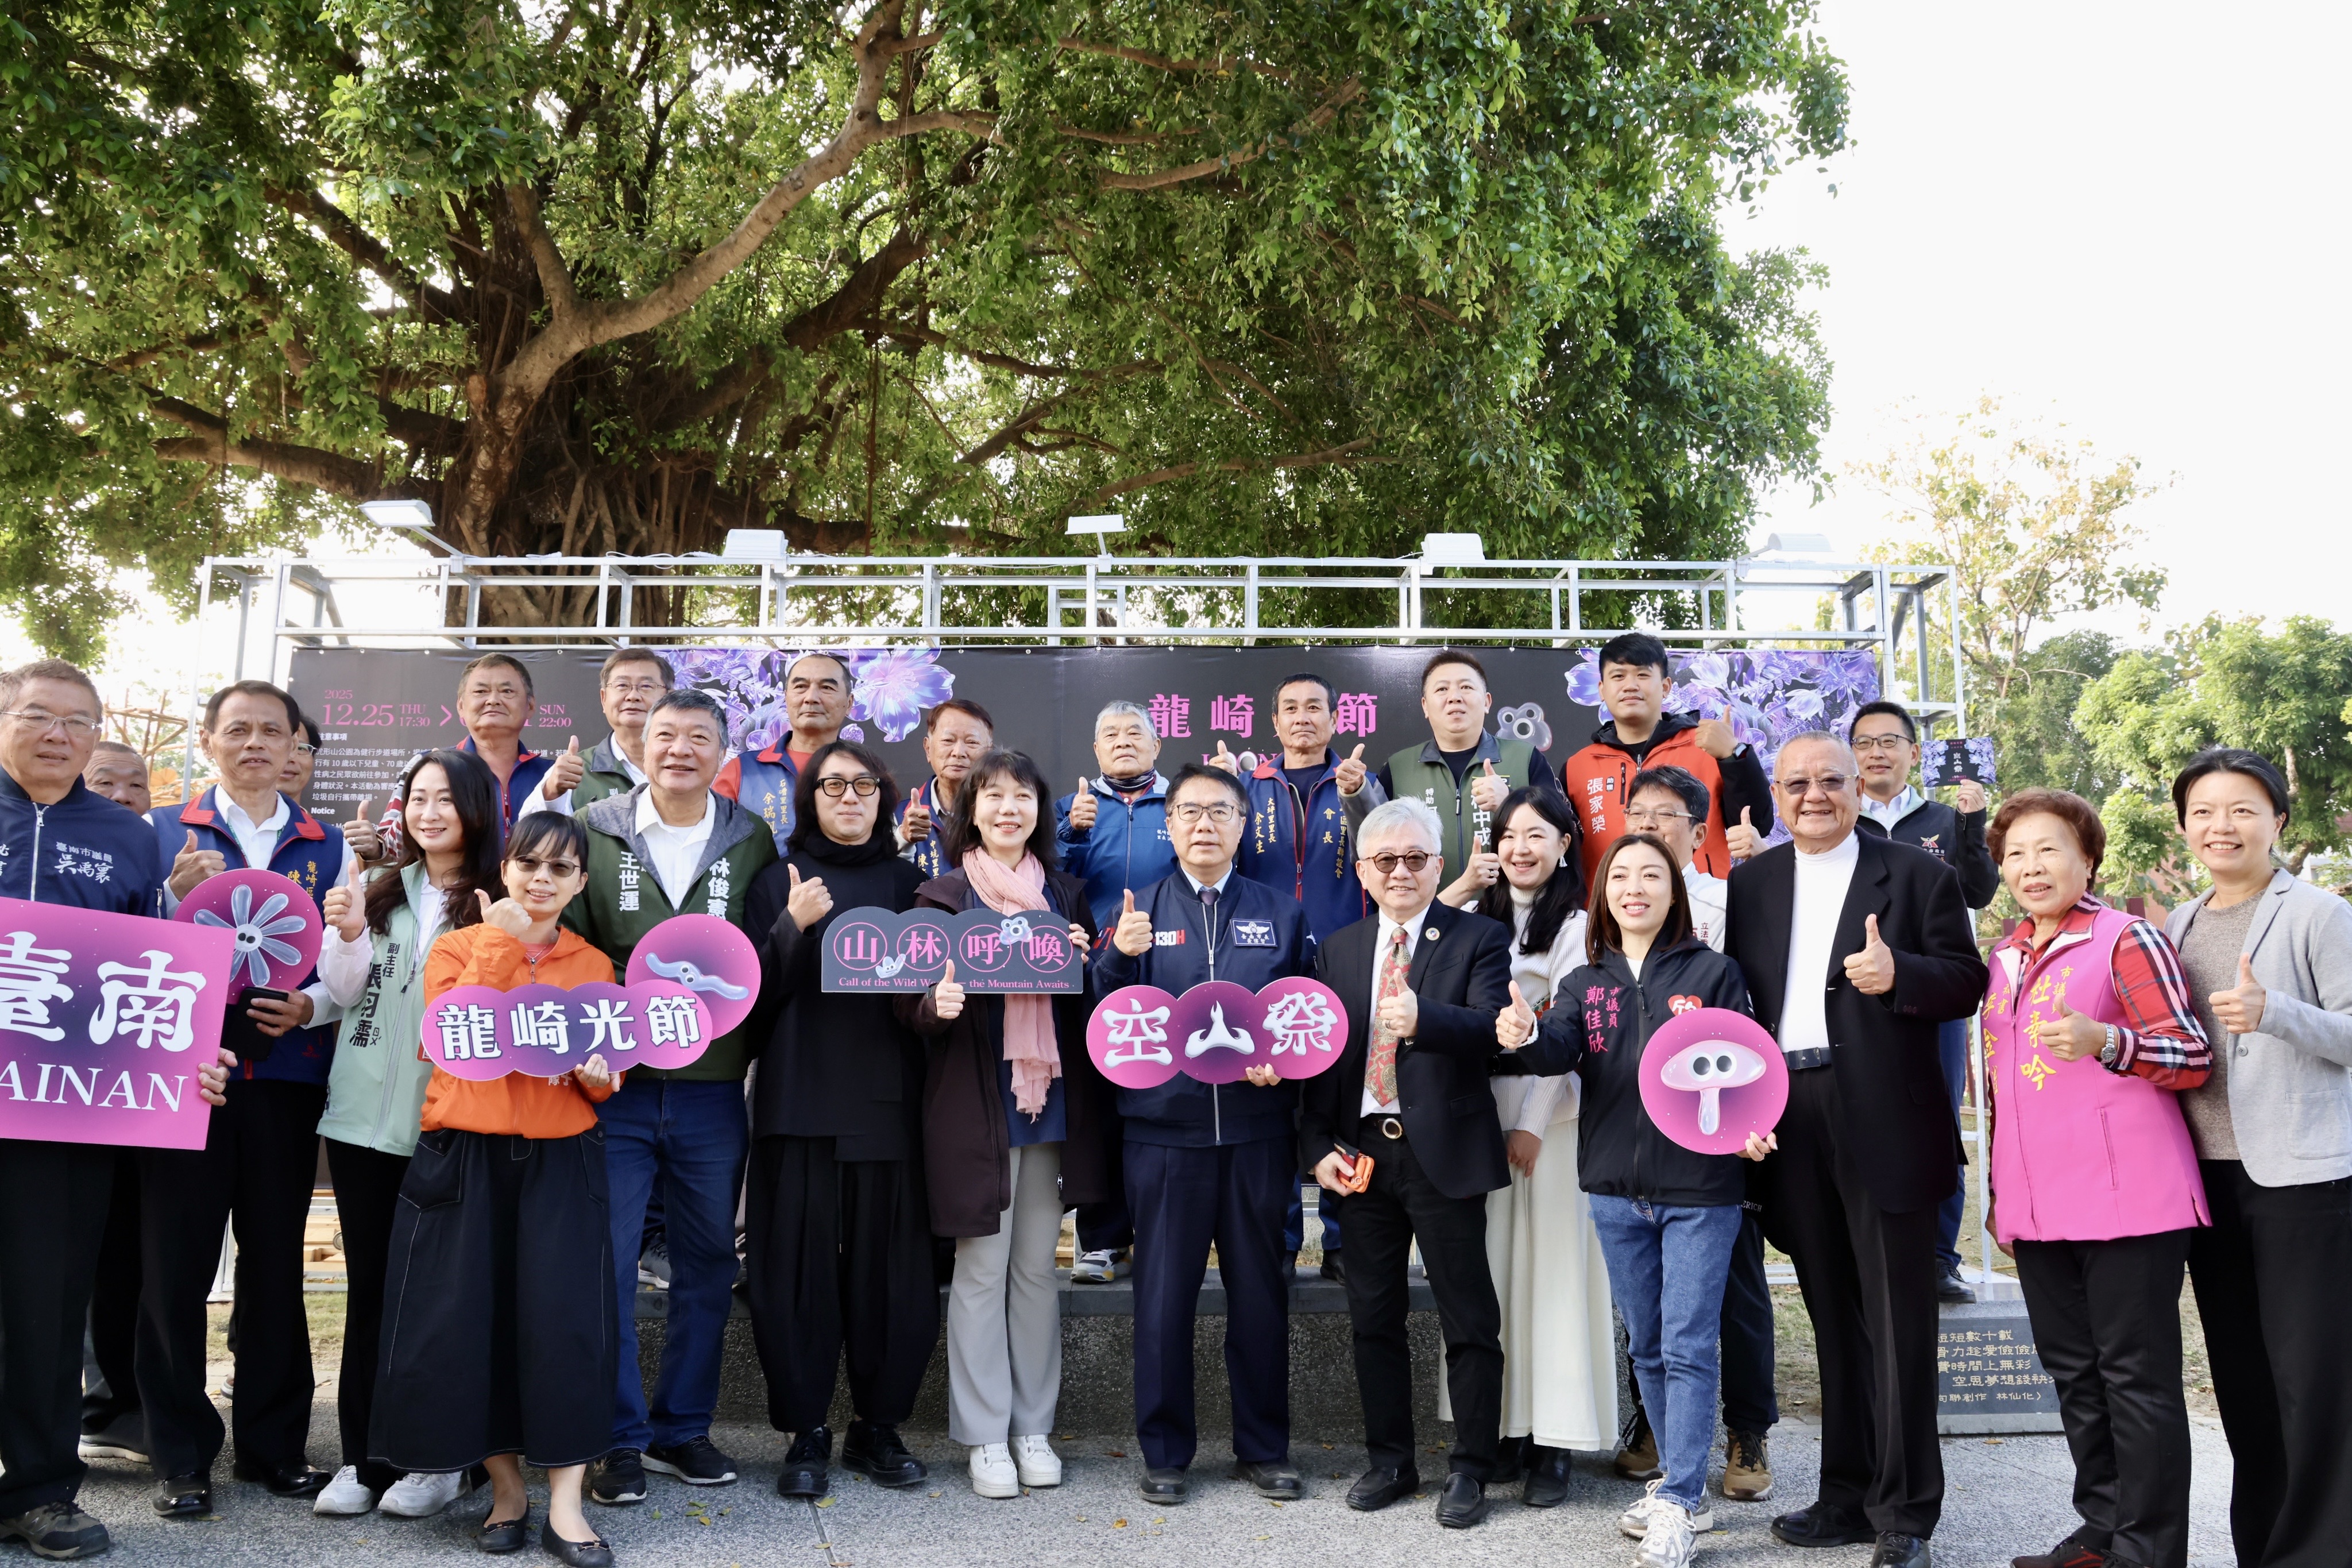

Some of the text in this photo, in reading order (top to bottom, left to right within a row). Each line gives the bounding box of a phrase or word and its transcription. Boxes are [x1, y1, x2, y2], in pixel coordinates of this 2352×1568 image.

[321, 704, 425, 726] 12.25 THU
[325, 689, 353, 699] 2025
[539, 705, 565, 715] SUN
[399, 717, 430, 727] 17:30
[539, 718, 571, 727] 22:00
[1148, 693, 1378, 739] 龍崎節
[315, 759, 330, 767] 行有
[313, 782, 400, 790] 身體狀況。本活動為響應
[1425, 787, 1434, 804] 特助
[1587, 777, 1606, 835] 張家榮
[1254, 812, 1265, 854] 余文生
[1267, 798, 1276, 843] 大坪里里長
[930, 840, 939, 879] 中坑里里
[1335, 808, 1347, 879] 區里長聯誼會
[619, 851, 640, 912] 王世運
[706, 857, 730, 921] 林俊憲
[383, 943, 401, 978] 副主任
[843, 929, 1065, 966] 山林呼喚
[0, 930, 207, 1052] 臺南
[839, 978, 858, 986] Call
[862, 978, 872, 986] of
[874, 979, 890, 987] the
[894, 979, 917, 987] Wild
[988, 980, 1033, 988] Mountain
[1036, 980, 1069, 988] Awaits
[2050, 966, 2074, 1014] 市議
[437, 994, 701, 1060] 龍崎光節
[1584, 986, 1608, 1053] 鄭佳欣
[1605, 986, 1621, 1028] 市議員
[1101, 991, 1338, 1069] 空山祭
